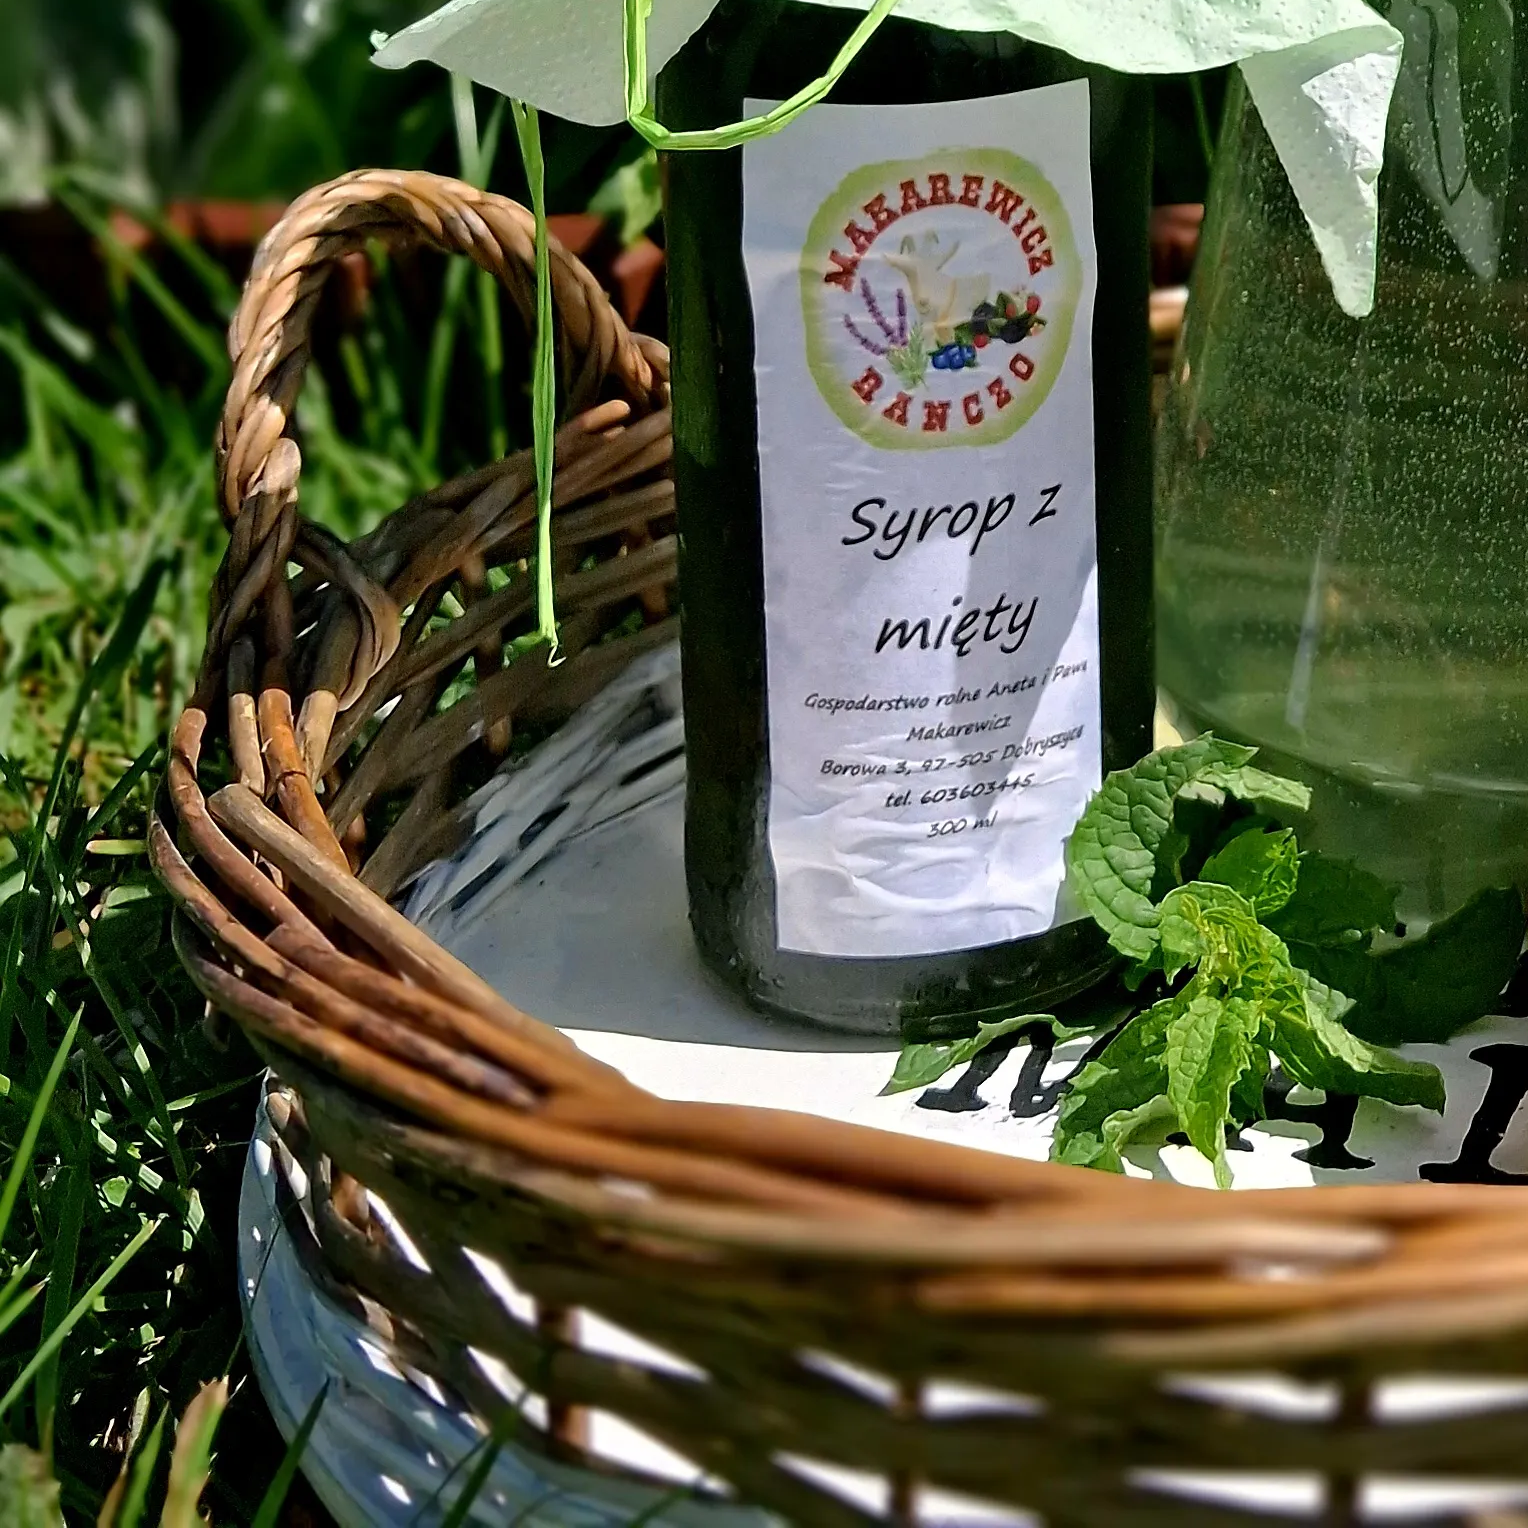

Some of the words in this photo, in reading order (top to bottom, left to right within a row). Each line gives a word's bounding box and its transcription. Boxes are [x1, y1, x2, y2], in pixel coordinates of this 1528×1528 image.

[824, 173, 1054, 293] MAKAREWICZ
[852, 353, 1035, 431] RANCZO
[841, 492, 1016, 560] Syrop
[1028, 482, 1062, 527] z
[875, 592, 1040, 657] mięty
[804, 692, 930, 716] Gospodarstwo
[935, 688, 981, 708] rolne
[986, 675, 1036, 699] Aneta
[906, 713, 1012, 742] Makarewicz
[820, 759, 887, 776] Borowa
[893, 760, 912, 776] 3,
[921, 749, 999, 773] 97-505
[885, 789, 912, 808] tel.
[920, 773, 1036, 805] 603603445
[926, 817, 968, 838] 300
[972, 810, 999, 830] ml
